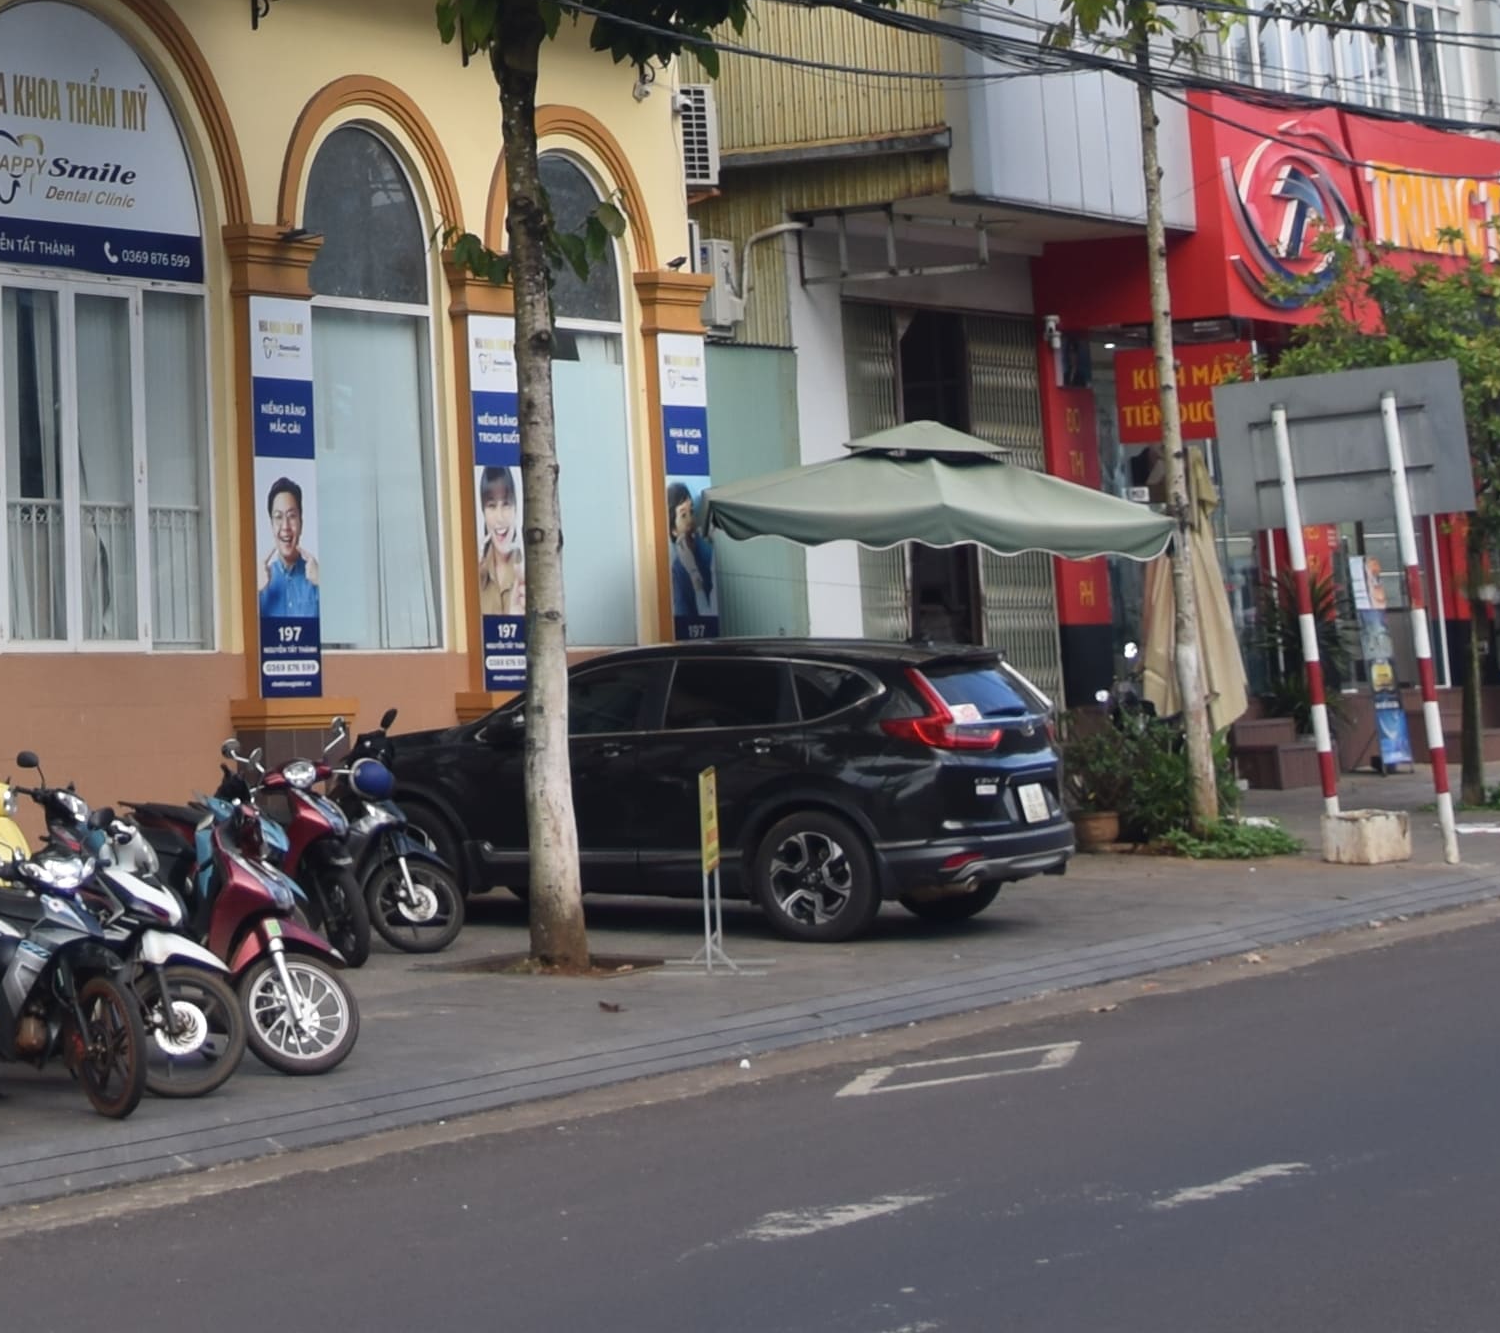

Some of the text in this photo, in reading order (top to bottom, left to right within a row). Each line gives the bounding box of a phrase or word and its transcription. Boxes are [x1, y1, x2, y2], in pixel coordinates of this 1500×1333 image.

[13, 73, 62, 121] KHOA
[121, 84, 148, 132] MỸ
[48, 157, 137, 185] Smile
[45, 186, 135, 208] Dental Clinic
[16, 235, 36, 253] TẤT
[39, 239, 75, 257] THÀNH
[121, 249, 191, 268] 0369 876 599
[278, 626, 302, 642] 197
[498, 624, 517, 639] 197
